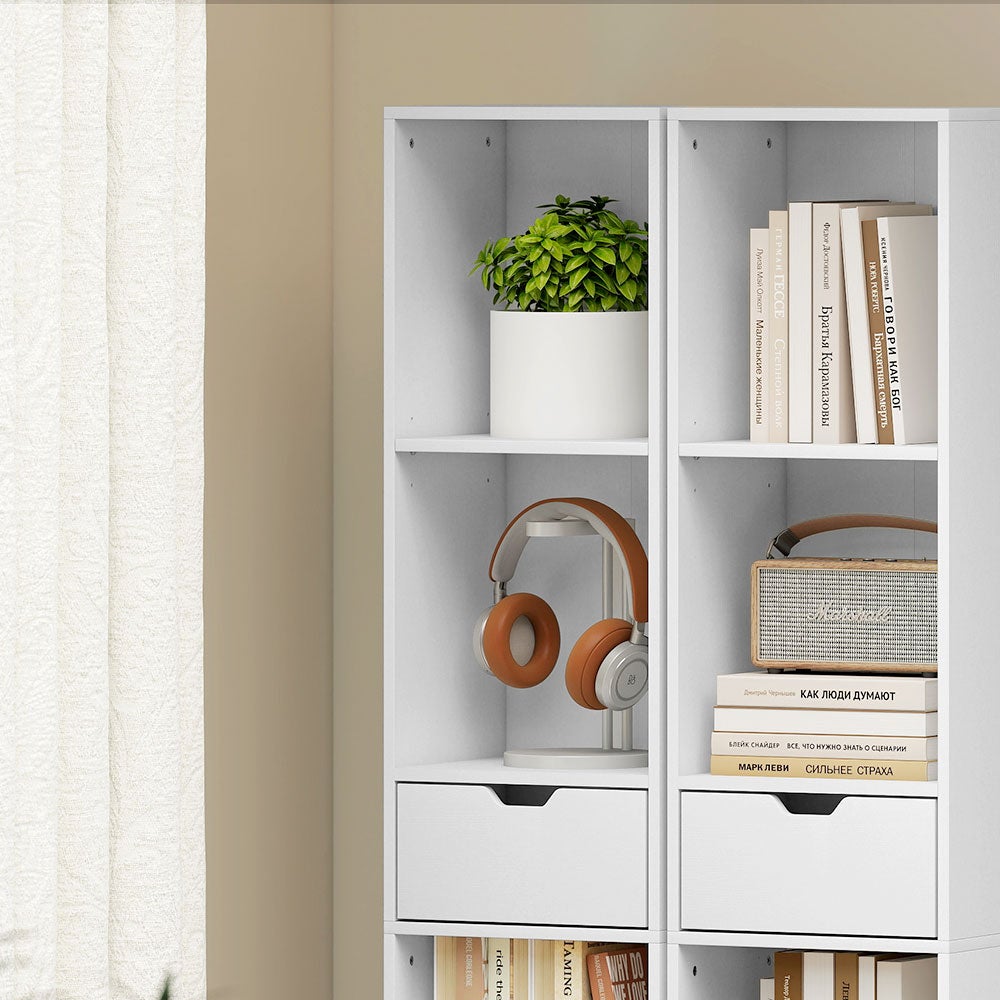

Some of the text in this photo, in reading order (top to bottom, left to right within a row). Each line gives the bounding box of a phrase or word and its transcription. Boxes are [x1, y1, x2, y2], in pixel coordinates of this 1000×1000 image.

[756, 248, 764, 270] Луиза
[880, 237, 890, 291] КСЕНИЯ ЧЕРНОВА
[756, 288, 764, 314] Олкотт
[774, 273, 785, 319] ГЕССЕ
[869, 261, 880, 314] НОРА РОБЕРТС
[818, 305, 833, 427] Братья Карамазовы
[884, 296, 901, 411] ГОВОРИ КАК БОГ
[754, 319, 764, 425] Маленькие женщины
[872, 332, 889, 429] Бархатная смерть
[807, 600, 892, 622] Marshall
[800, 690, 896, 701] КАК ЛЮДИ ДУМАЮТ
[728, 740, 780, 749] БЛЕЙК СНАЙДЕР
[816, 743, 842, 751] НУЖНО
[871, 744, 907, 752] СЦЕНАРИИ
[738, 763, 789, 772] МАРК ЛЕВИ
[805, 764, 893, 776] СИЛЬНЕЕ СТРАХА
[496, 949, 504, 976] ride
[563, 940, 575, 996] TAMING
[605, 951, 644, 982] WHY DO
[783, 975, 791, 996] Теодор
